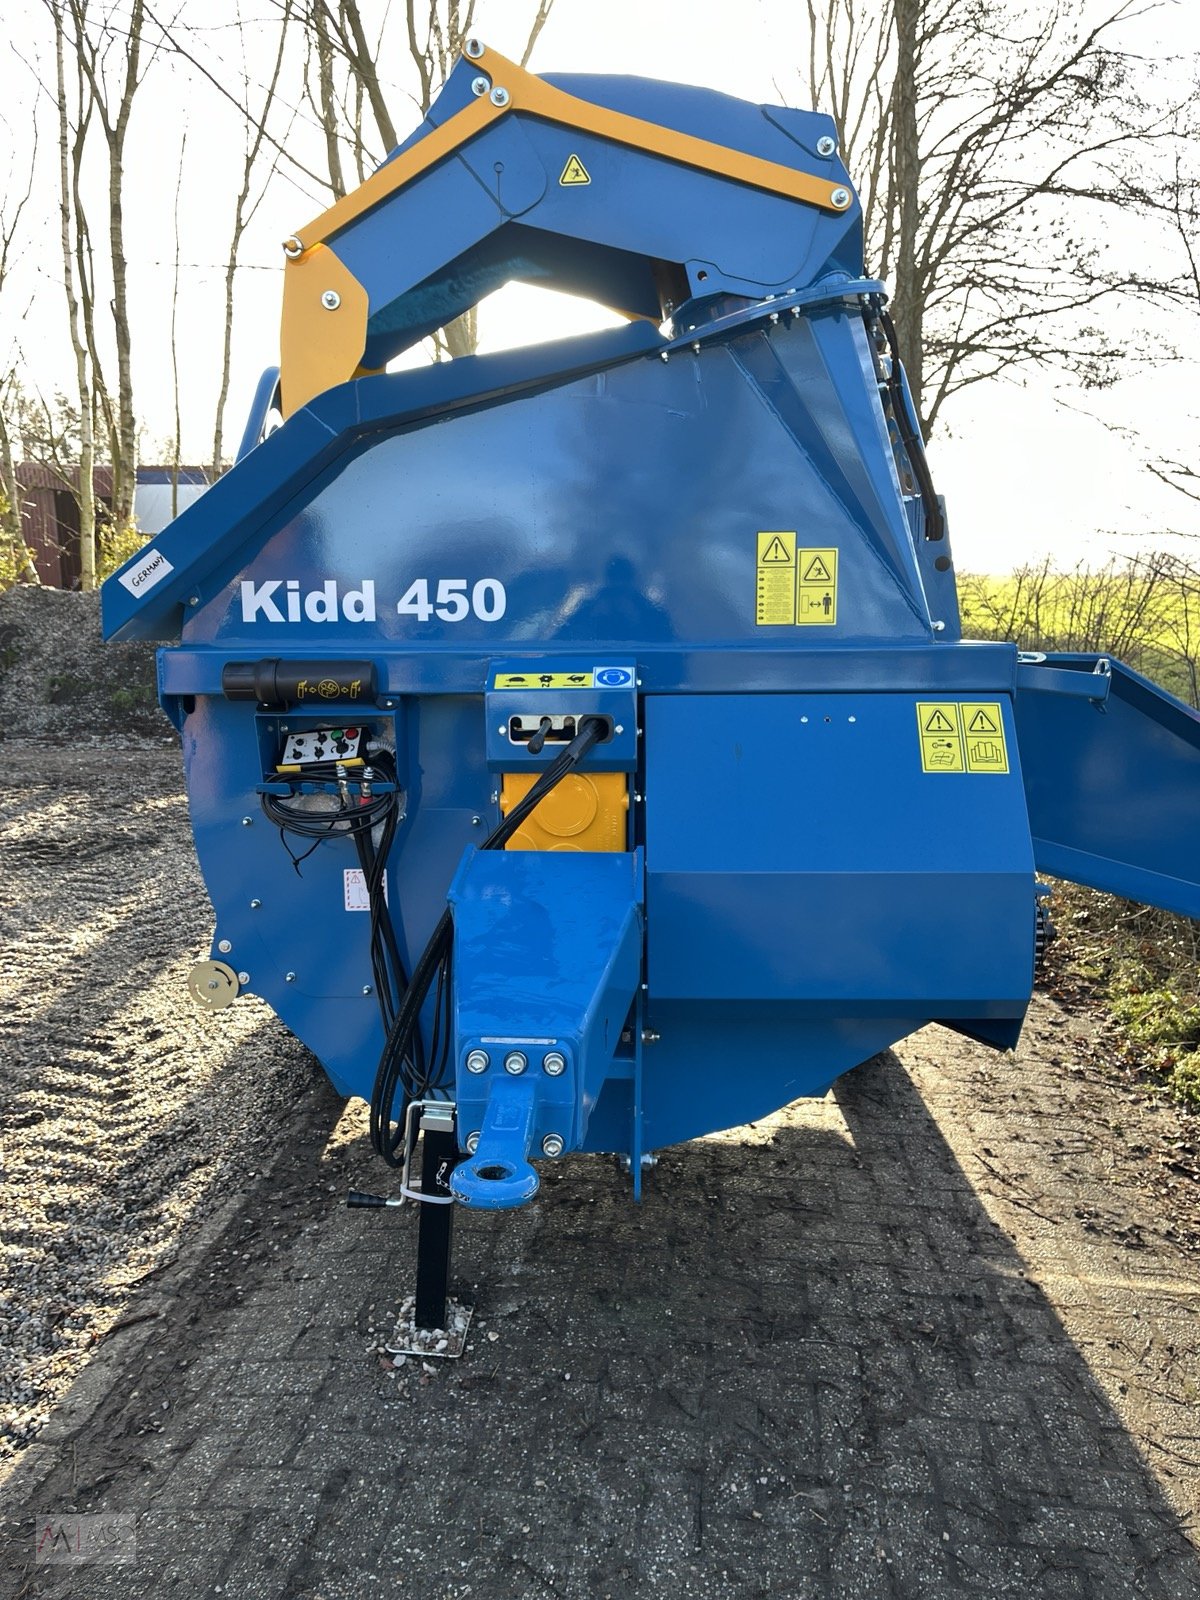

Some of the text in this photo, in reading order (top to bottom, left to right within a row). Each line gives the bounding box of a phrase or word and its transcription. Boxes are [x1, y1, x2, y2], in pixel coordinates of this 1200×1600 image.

[131, 555, 164, 587] GERMANY
[241, 578, 507, 622] Kidd 450
